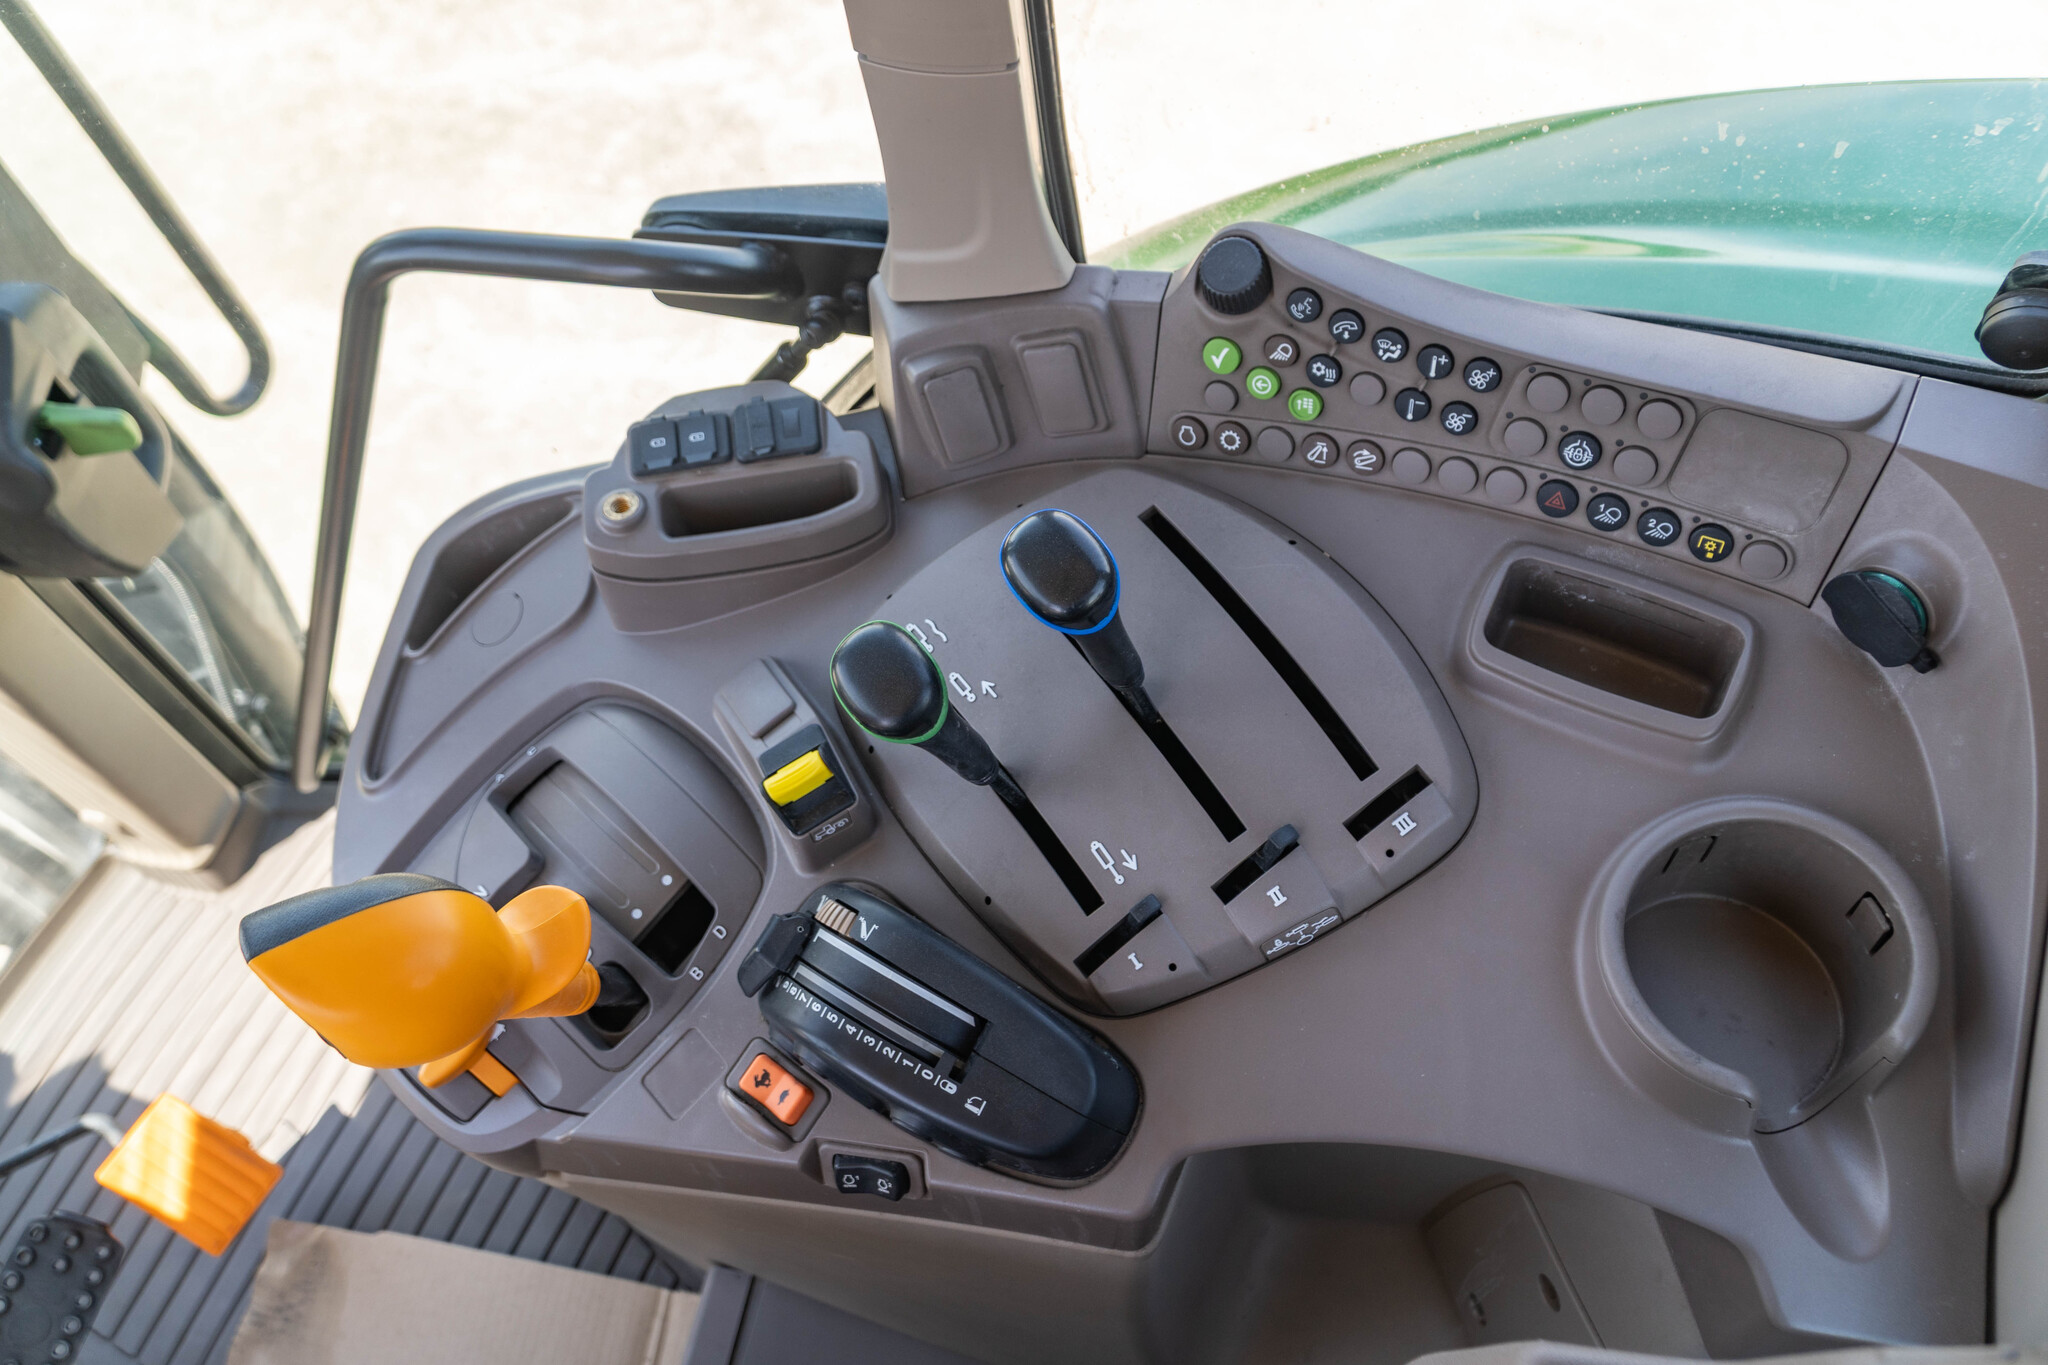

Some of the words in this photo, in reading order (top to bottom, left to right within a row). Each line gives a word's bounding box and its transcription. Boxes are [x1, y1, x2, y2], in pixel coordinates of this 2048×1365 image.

[1648, 518, 1657, 528] 2
[1392, 811, 1417, 836] III
[1266, 885, 1287, 907] II
[712, 925, 727, 939] D
[690, 966, 704, 981] B
[789, 986, 798, 995] 8
[798, 992, 807, 1002] 7
[811, 1002, 822, 1012] 6
[826, 1012, 838, 1023] 5
[845, 1024, 857, 1035] 4
[863, 1035, 876, 1046] 3
[882, 1046, 896, 1059] 2
[902, 1058, 914, 1067] 1
[921, 1069, 934, 1080] 0
